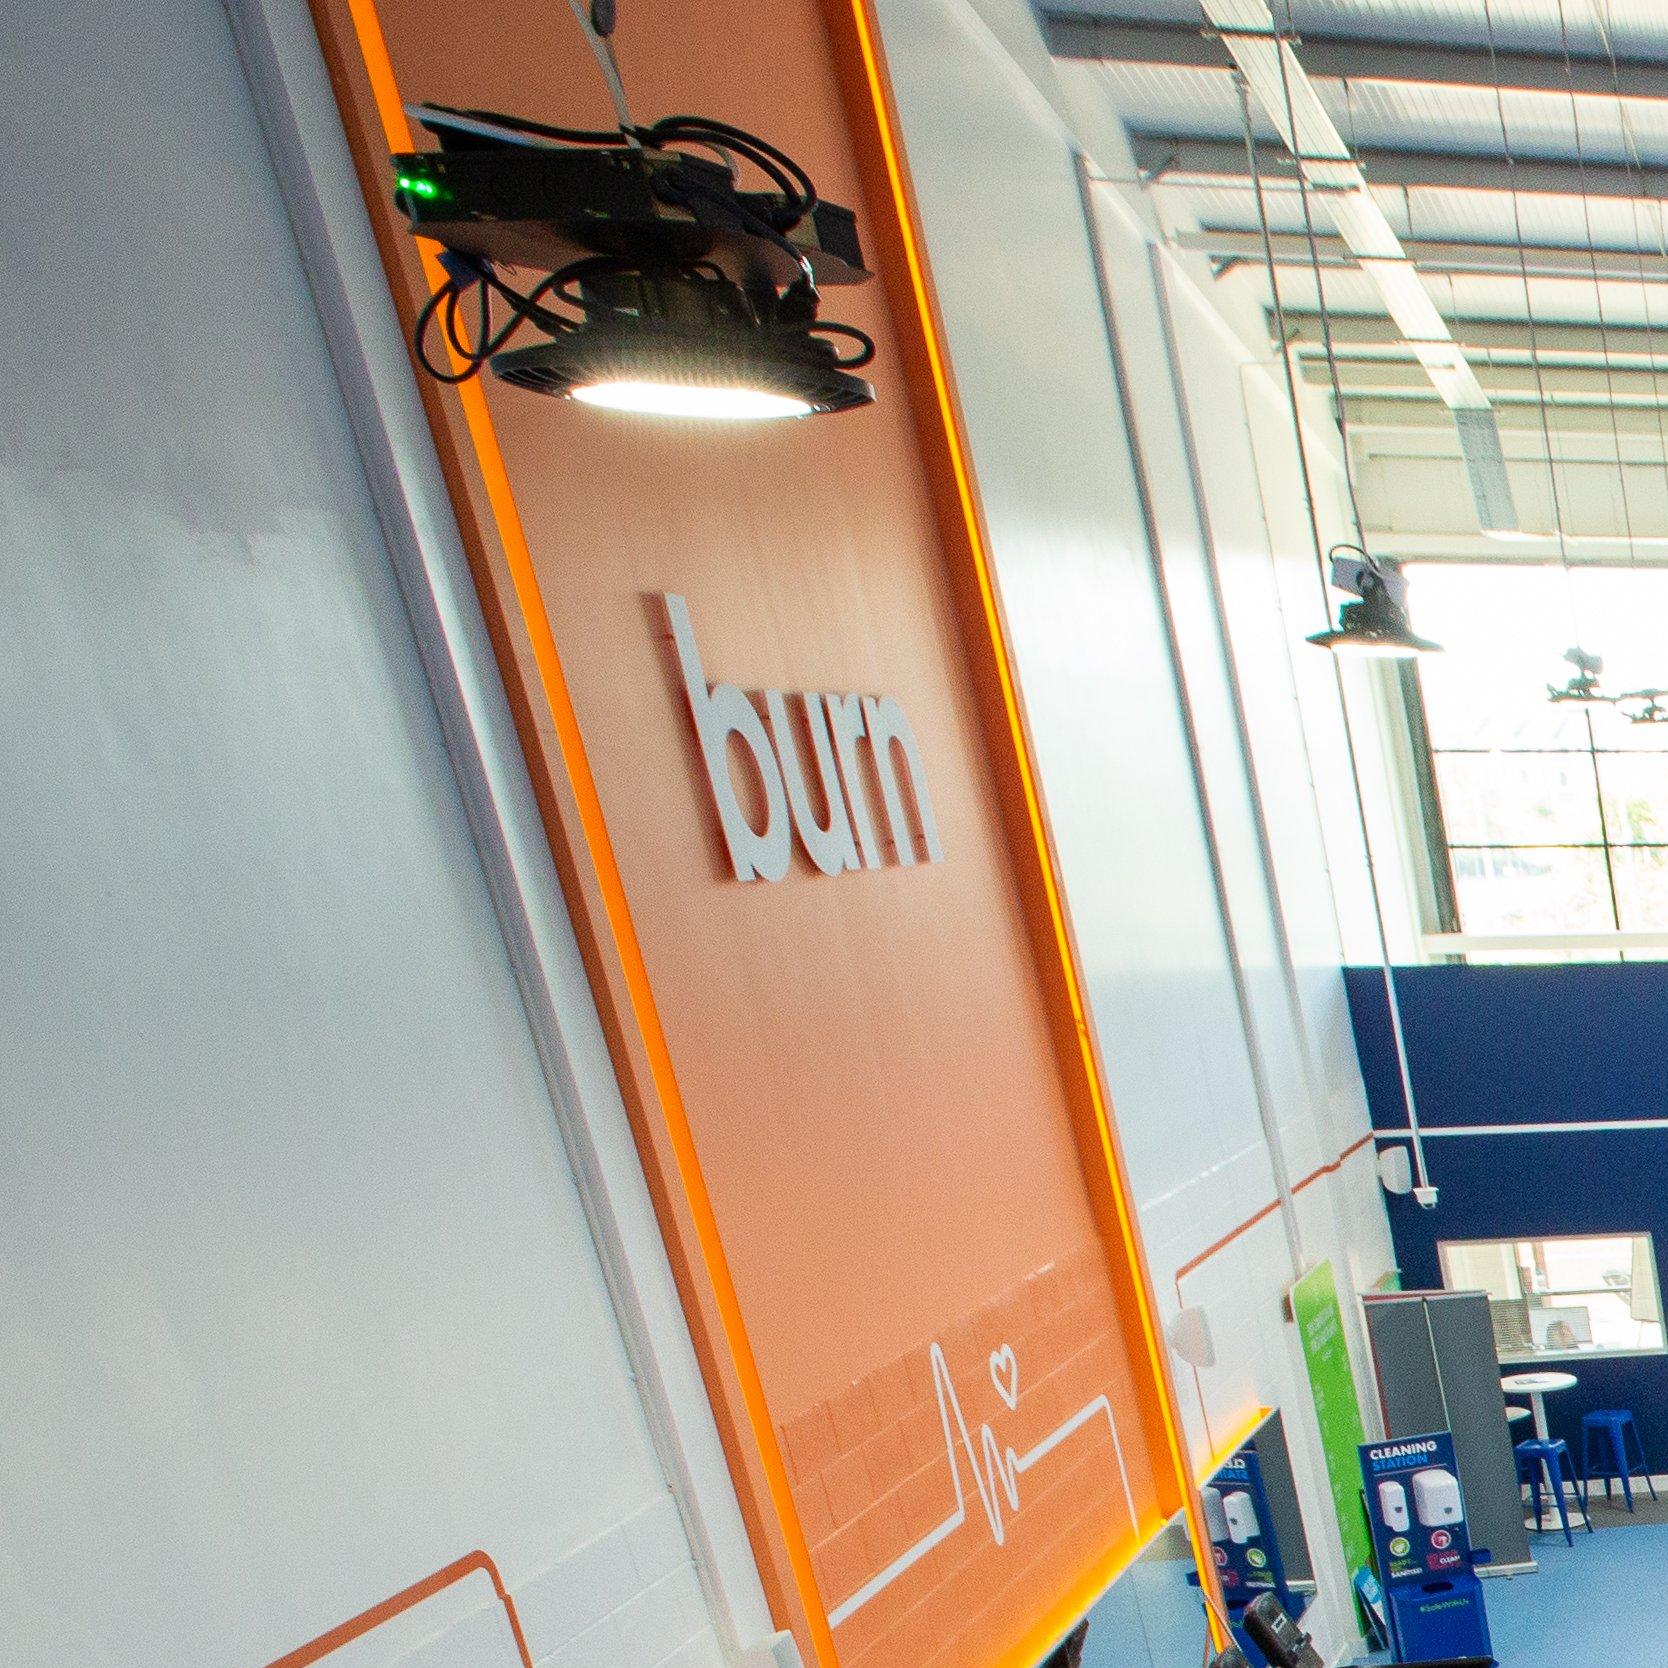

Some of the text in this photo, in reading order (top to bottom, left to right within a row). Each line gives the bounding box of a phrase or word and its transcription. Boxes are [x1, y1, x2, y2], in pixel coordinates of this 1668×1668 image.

[664, 592, 944, 884] burn
[1370, 1440, 1437, 1460] CLEANING
[1372, 1454, 1429, 1471] STATION
